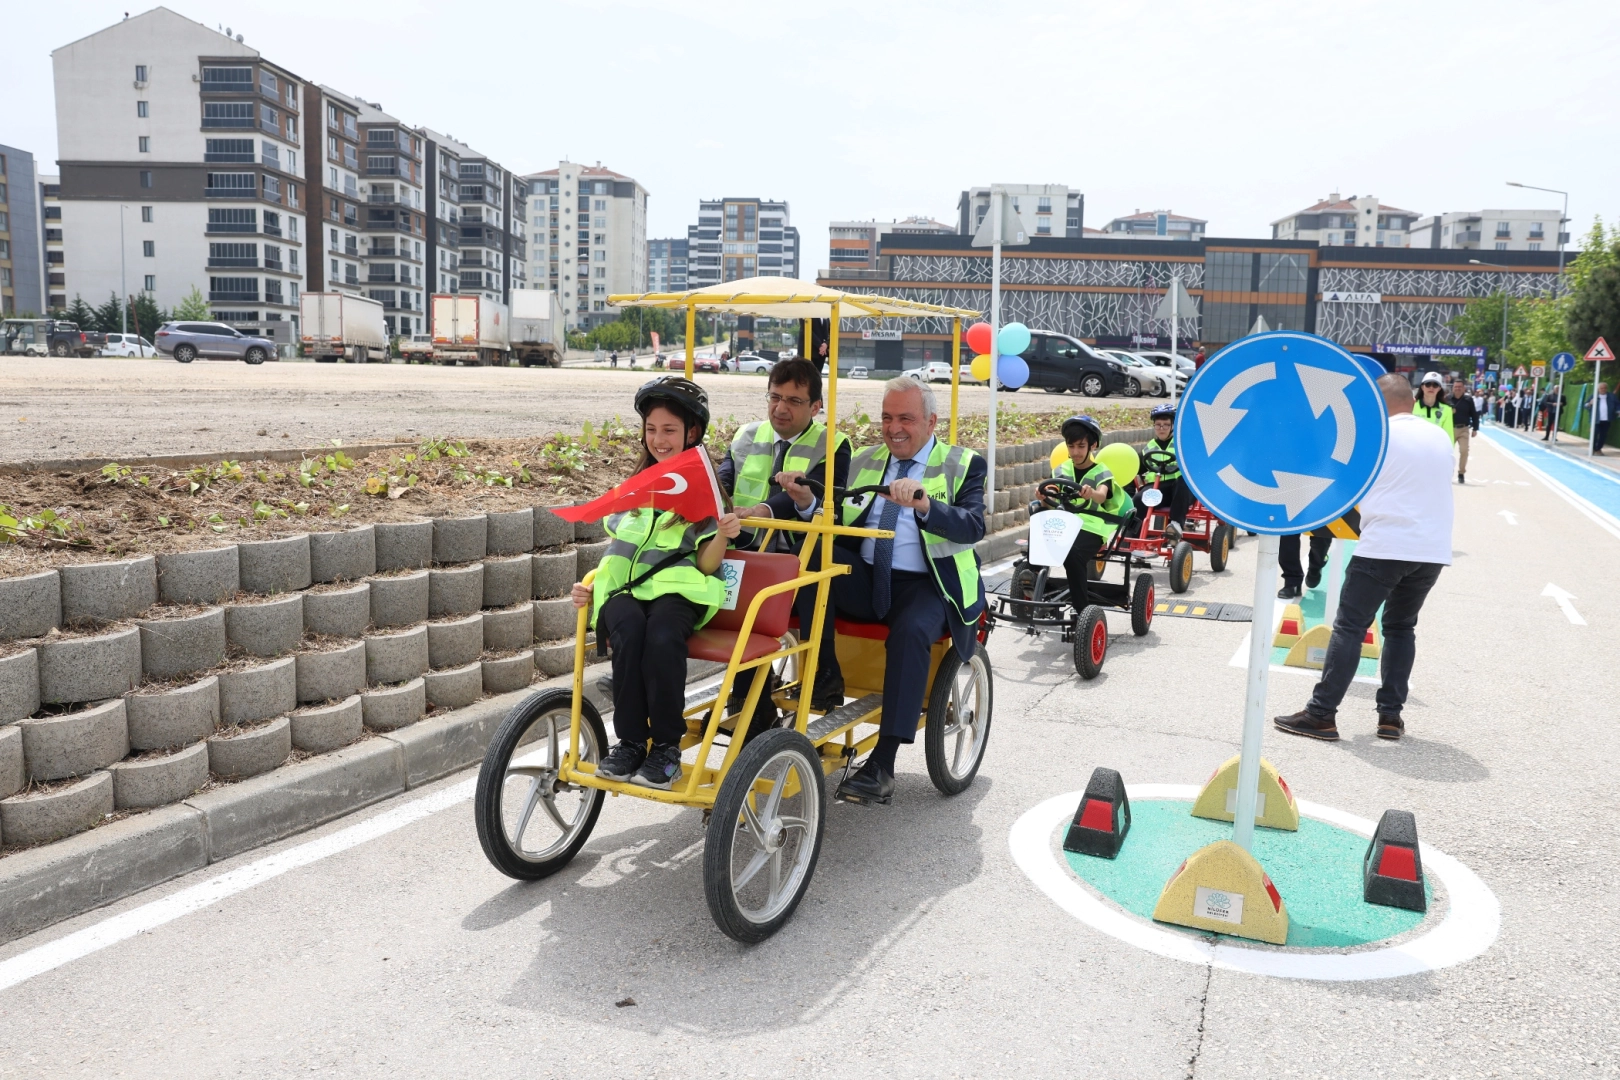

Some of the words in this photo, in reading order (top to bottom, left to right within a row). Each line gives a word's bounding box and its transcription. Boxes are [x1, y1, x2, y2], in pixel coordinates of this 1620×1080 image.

[1344, 293, 1374, 302] ALFA
[1386, 345, 1413, 354] TRAFİK
[1413, 346, 1440, 355] EĞİTİM
[1440, 347, 1471, 356] SOKAĞI
[927, 490, 947, 500] RAFİK
